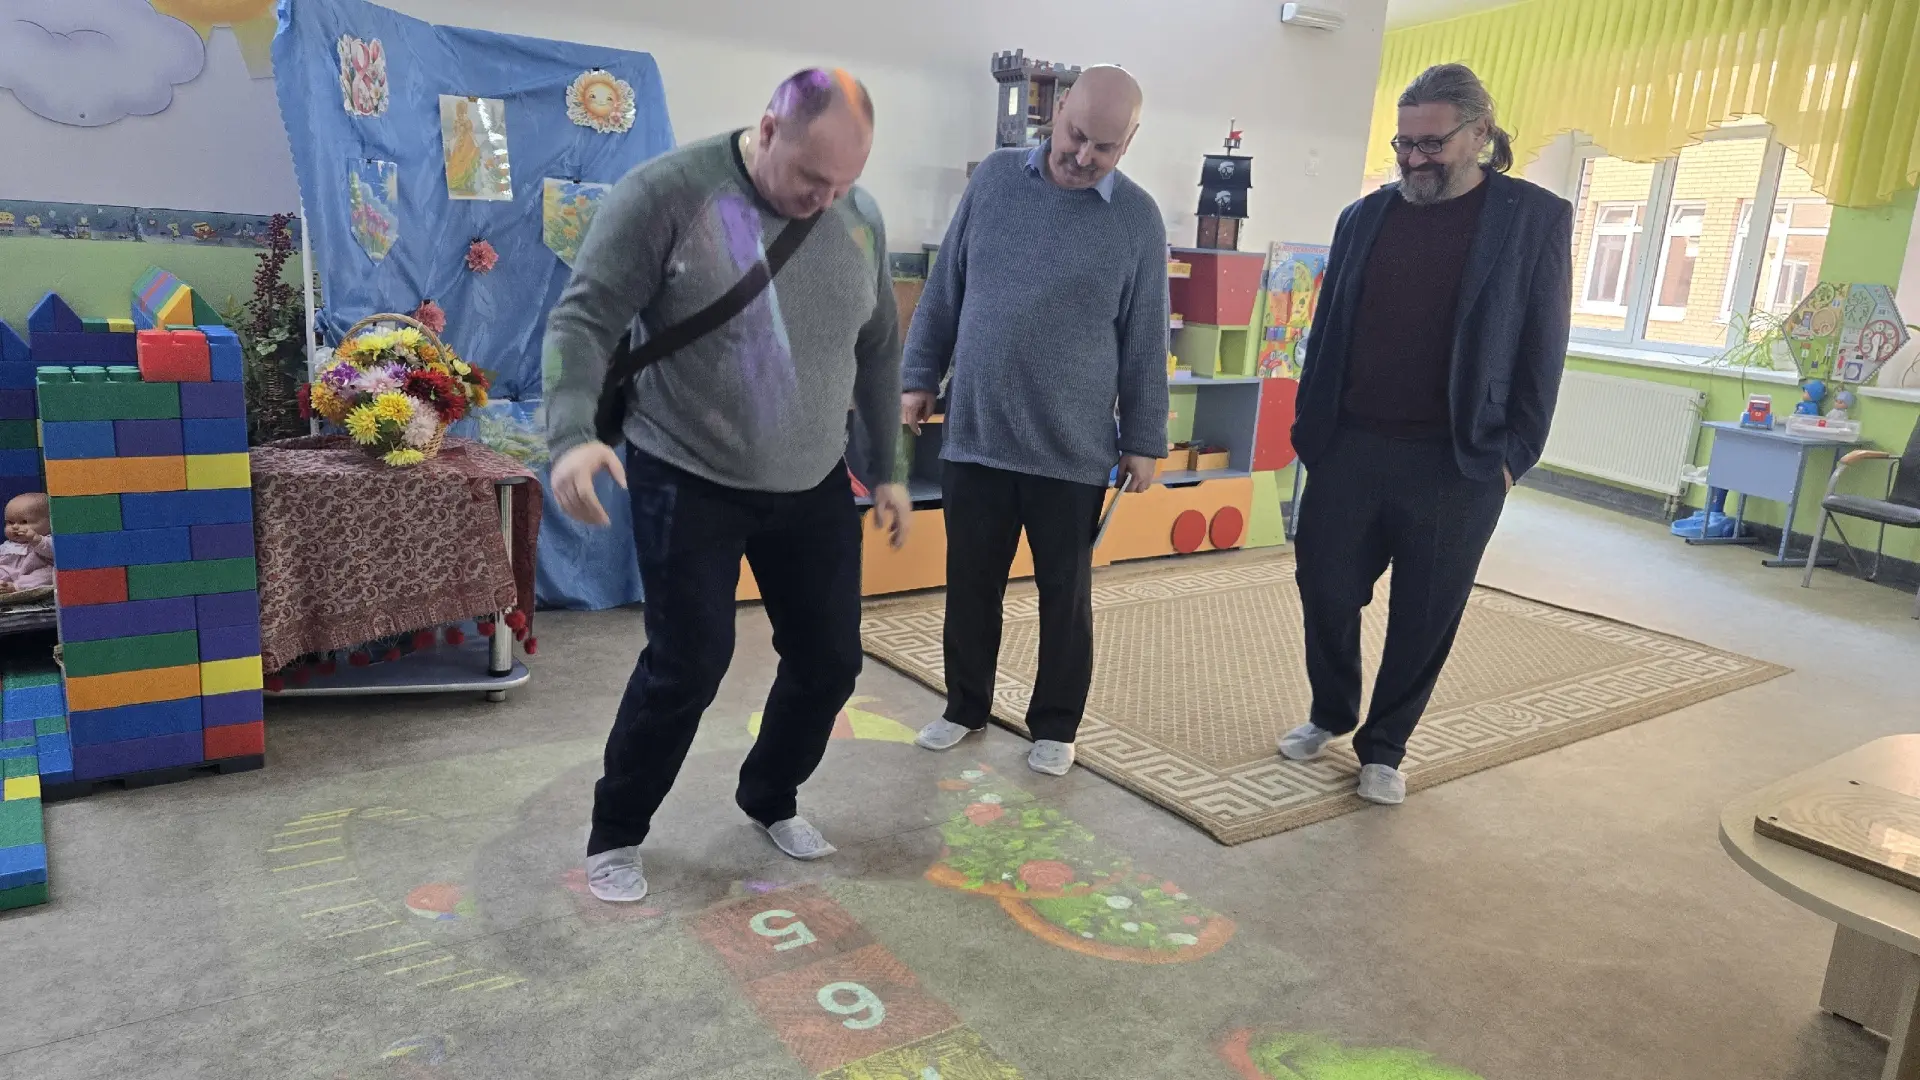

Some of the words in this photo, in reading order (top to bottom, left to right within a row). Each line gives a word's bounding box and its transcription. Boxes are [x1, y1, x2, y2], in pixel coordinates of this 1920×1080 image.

[351, 40, 373, 113] 8
[749, 909, 818, 951] 5
[816, 981, 886, 1030] 6
